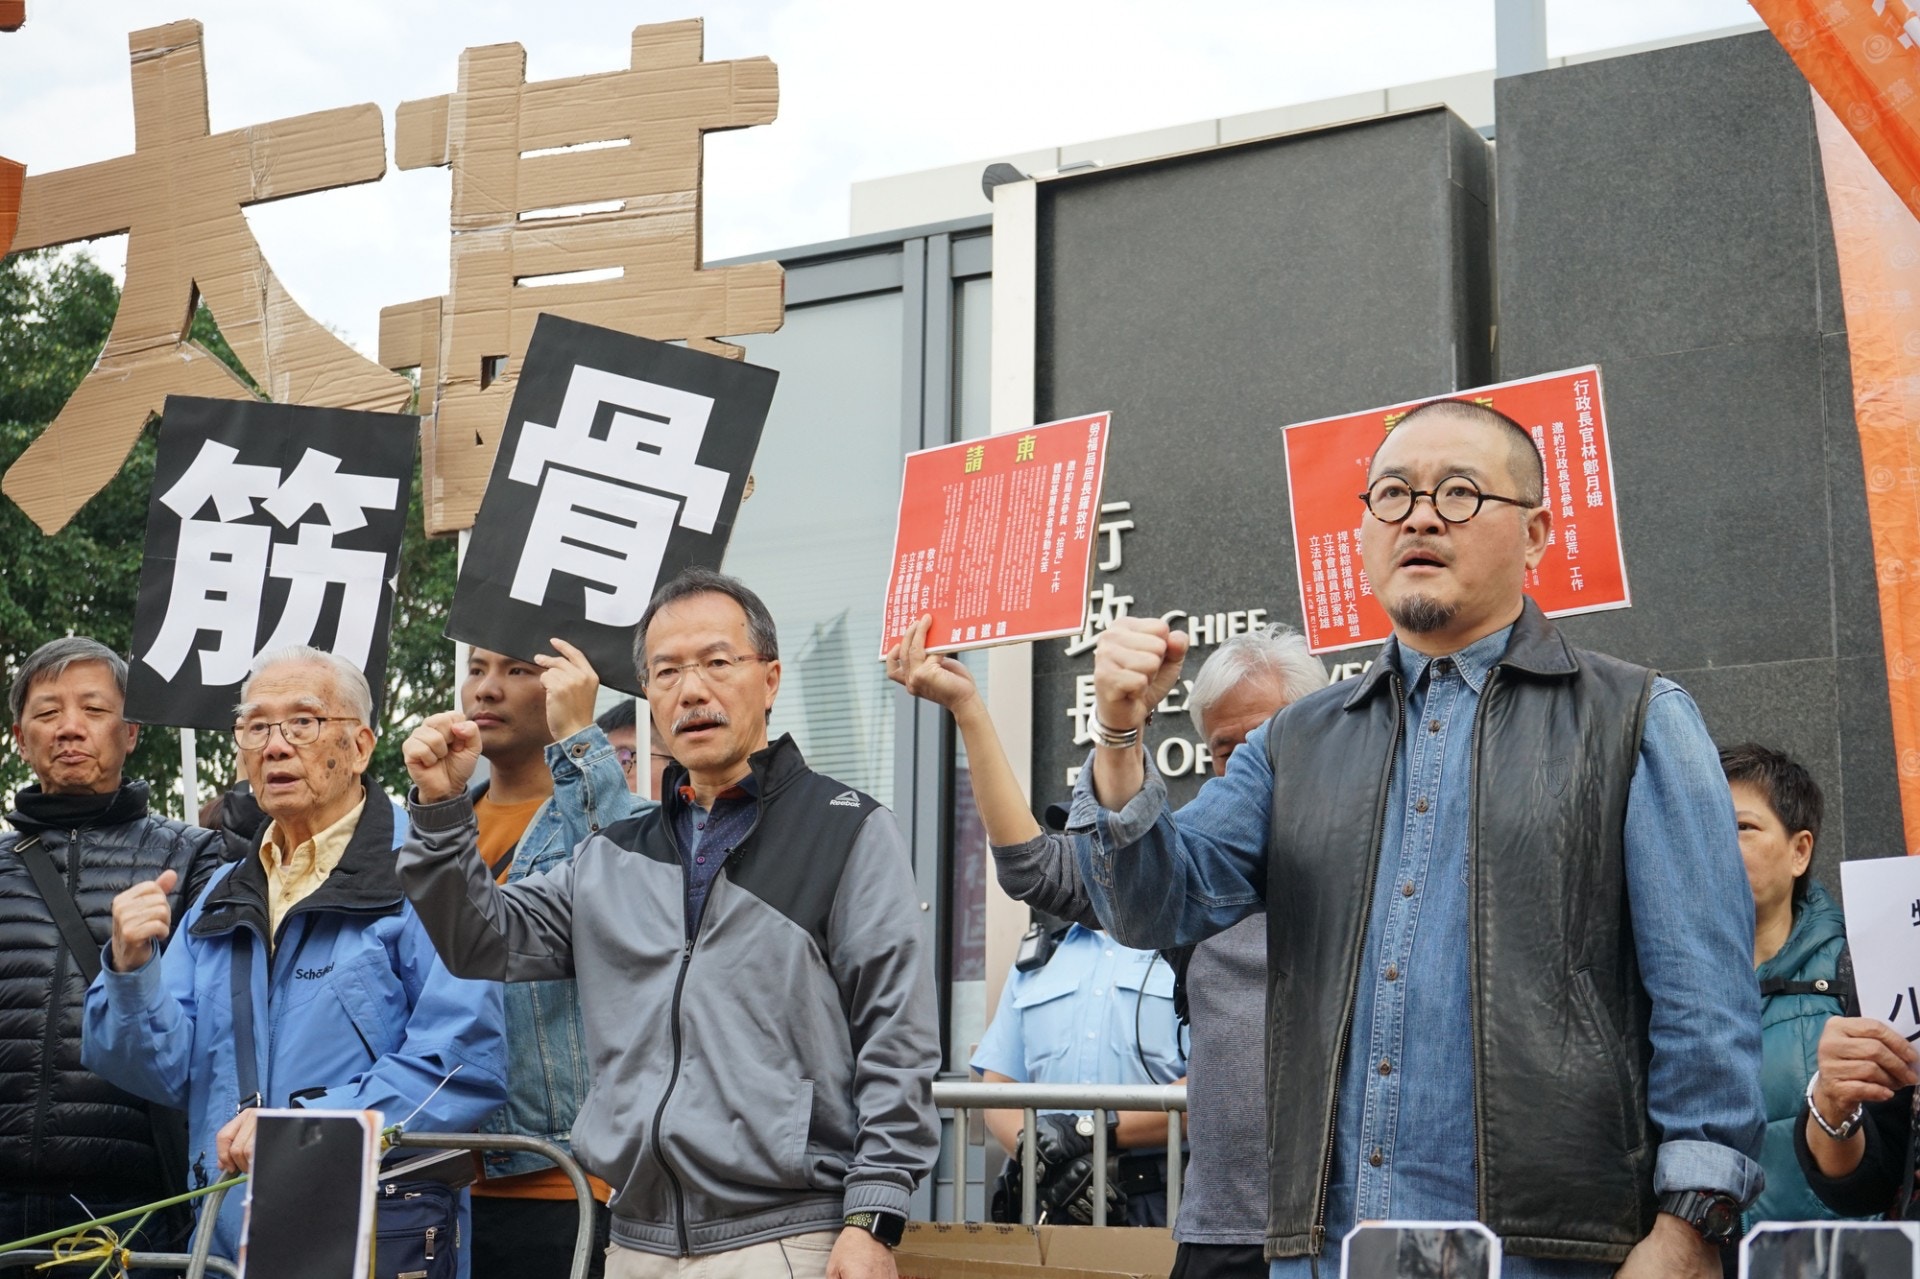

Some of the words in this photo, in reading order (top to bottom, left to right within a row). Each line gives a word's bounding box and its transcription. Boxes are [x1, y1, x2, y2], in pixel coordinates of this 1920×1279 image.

[507, 365, 731, 628] 骨
[1573, 379, 1604, 508] 行政長官林鄭月娥
[142, 439, 400, 685] 筋
[1309, 535, 1331, 629] 立法會議員張超雄
[1337, 531, 1361, 637] 捍衛綜援權利大聯盟
[829, 799, 861, 807] Reebok
